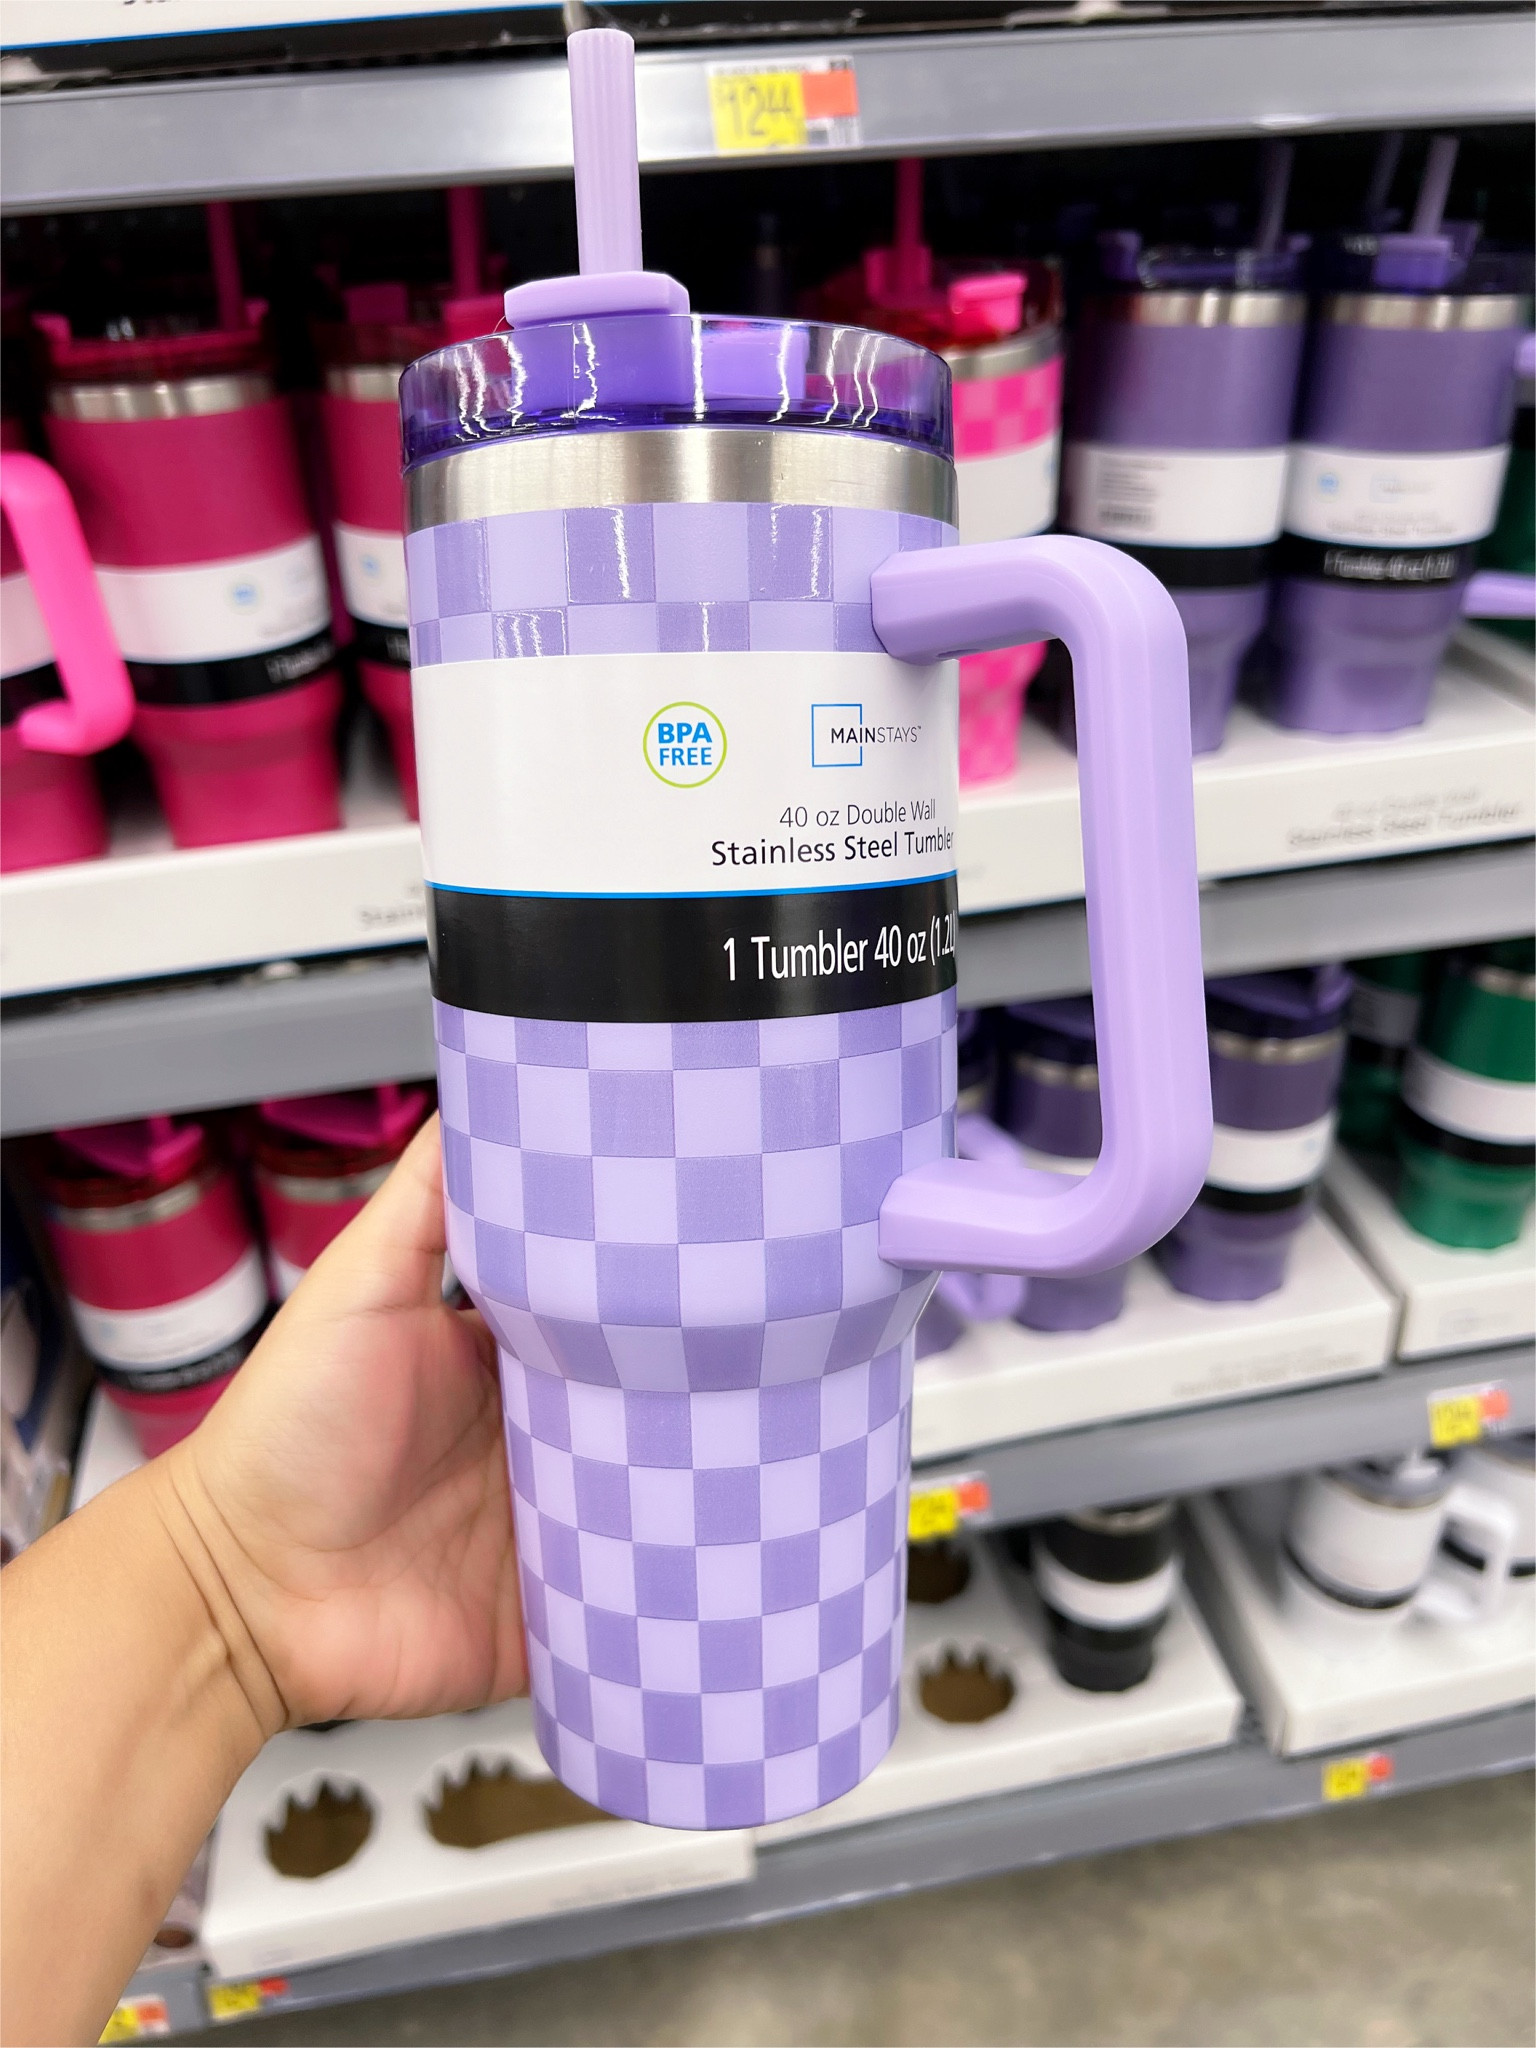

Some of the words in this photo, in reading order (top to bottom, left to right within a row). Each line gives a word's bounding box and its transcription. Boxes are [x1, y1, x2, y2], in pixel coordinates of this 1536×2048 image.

[657, 722, 713, 744] BPA
[659, 747, 713, 767] FREE
[779, 806, 808, 828] 40
[816, 809, 840, 827] oz
[847, 800, 907, 825] Double
[910, 799, 936, 822] Wall
[711, 836, 835, 866] Stainless
[844, 831, 898, 861] Steel
[904, 826, 954, 855] Tumbler
[723, 937, 736, 981] 1
[751, 929, 869, 980] Tumbler
[874, 925, 902, 969] 40
[907, 931, 927, 963] oz
